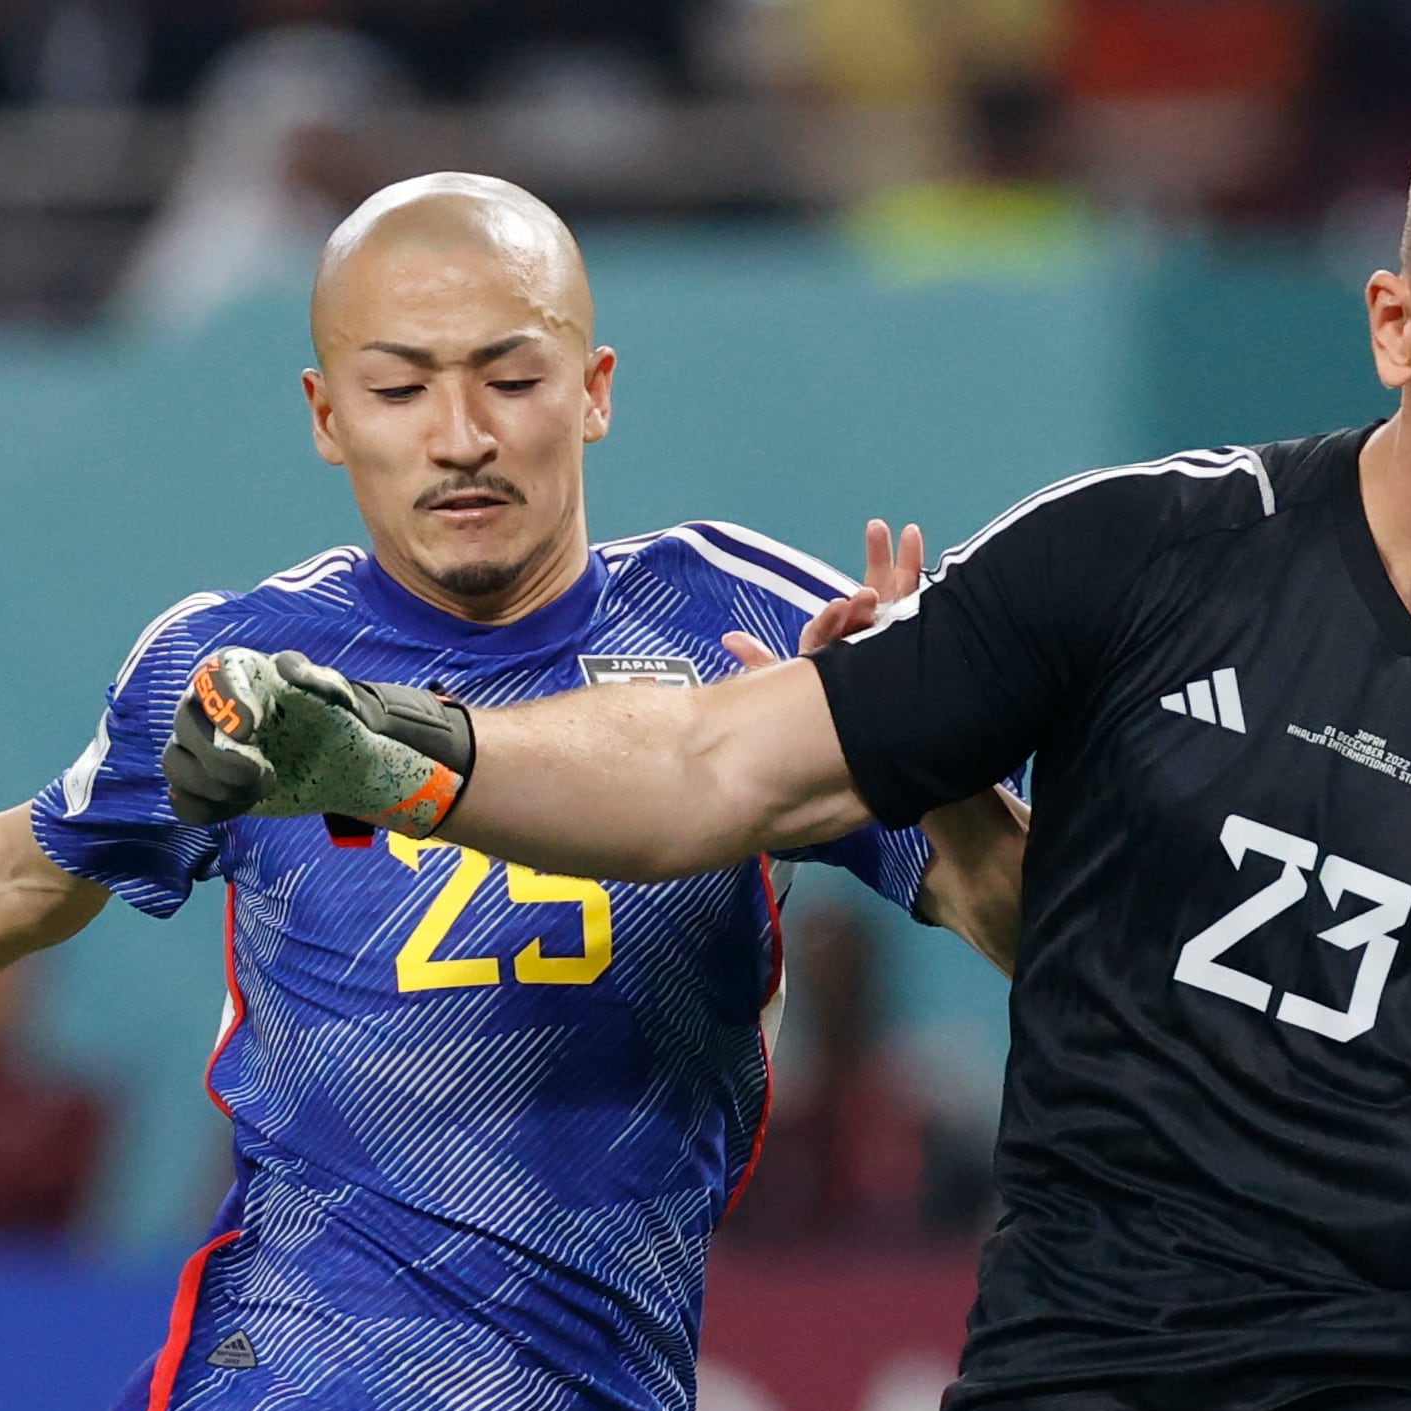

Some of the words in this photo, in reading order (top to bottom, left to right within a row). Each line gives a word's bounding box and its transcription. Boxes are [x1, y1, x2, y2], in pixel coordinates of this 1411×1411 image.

[610, 660, 668, 671] JAPAN
[1287, 724, 1325, 746] KHALIFA
[1327, 737, 1397, 777] INTERNATIONAL
[1324, 725, 1336, 738] 01
[1337, 731, 1384, 759] DECEMBER
[1384, 752, 1411, 771] 2022
[1354, 729, 1387, 749] JAPAN
[388, 830, 613, 993] 25
